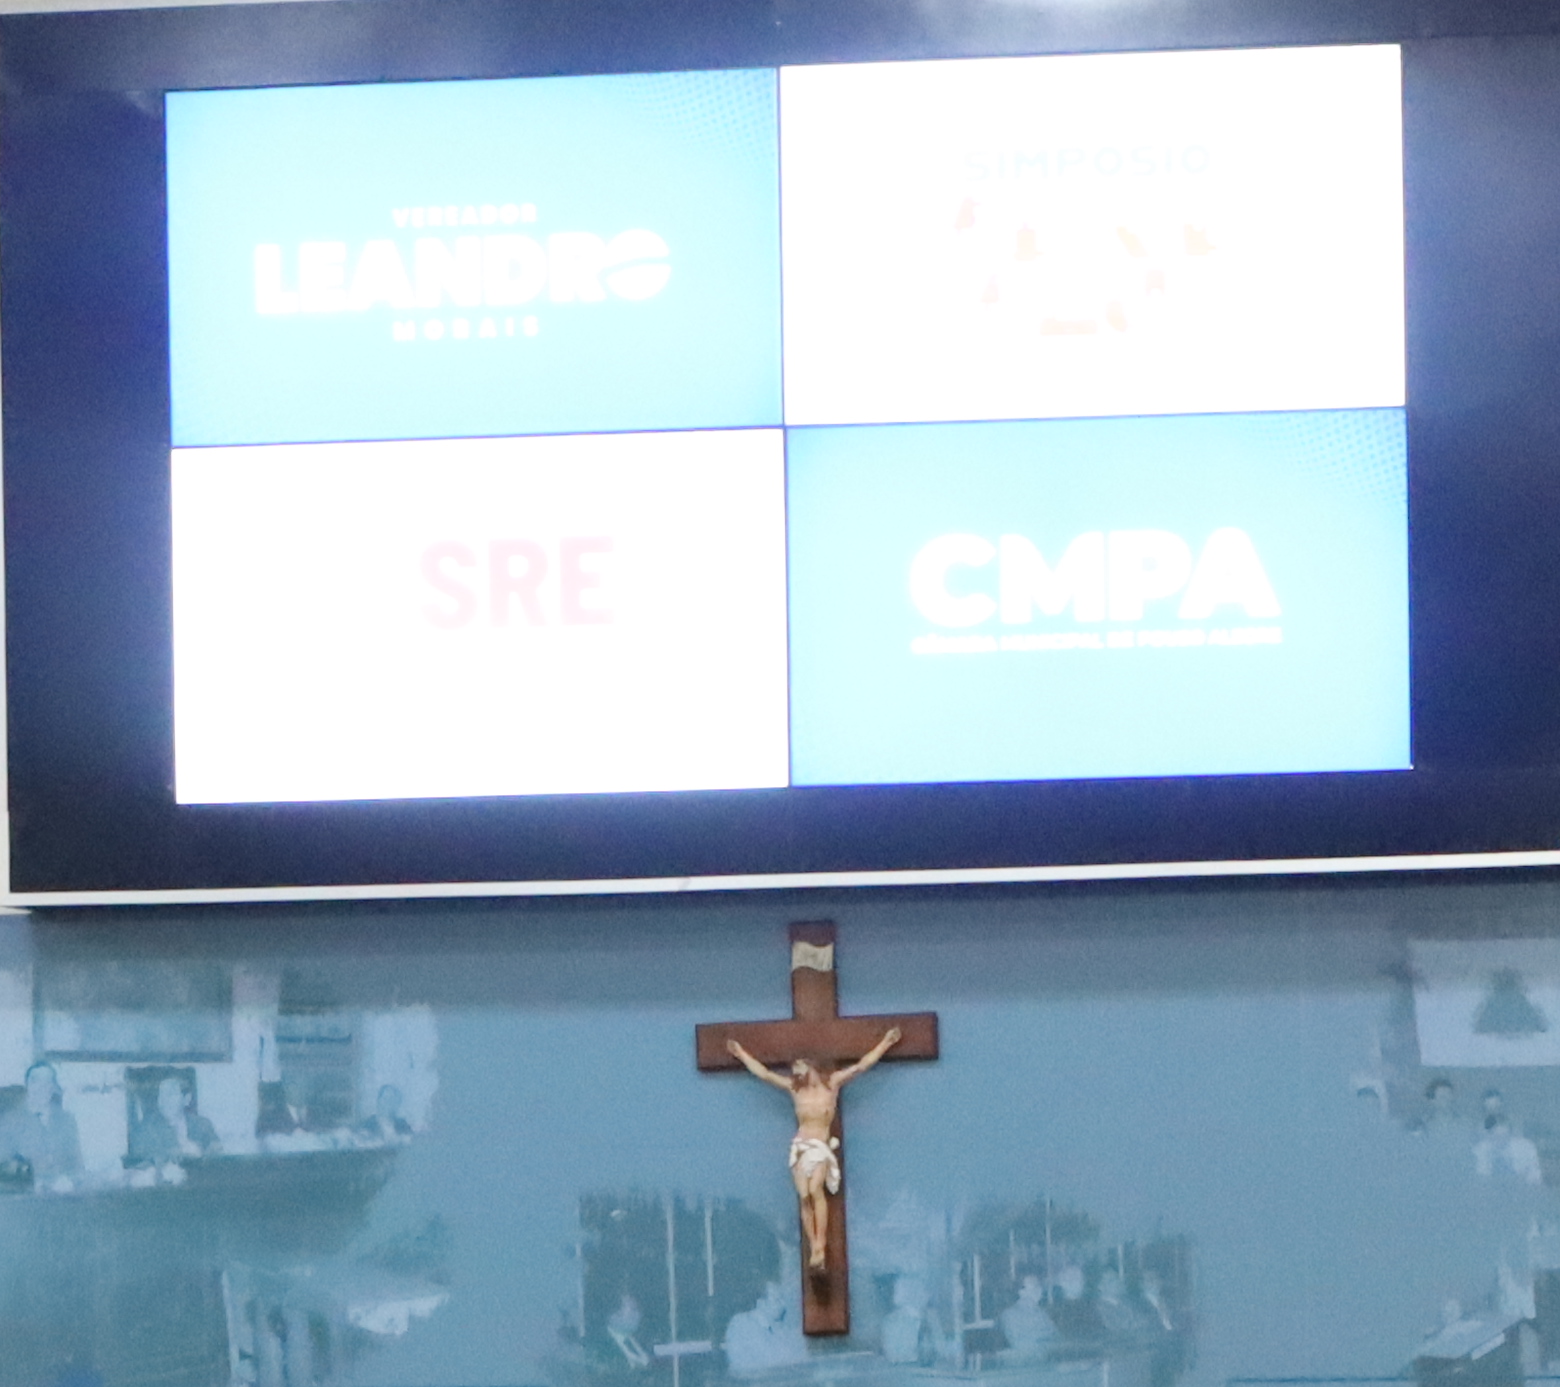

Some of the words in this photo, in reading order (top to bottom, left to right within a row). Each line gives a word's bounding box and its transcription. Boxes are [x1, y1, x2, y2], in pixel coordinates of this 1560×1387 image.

[392, 203, 538, 228] VEREADOR
[254, 229, 672, 315] LEANDRO
[393, 315, 539, 341] MORAIS
[419, 535, 615, 630] SRE
[909, 527, 1282, 628] CMPA
